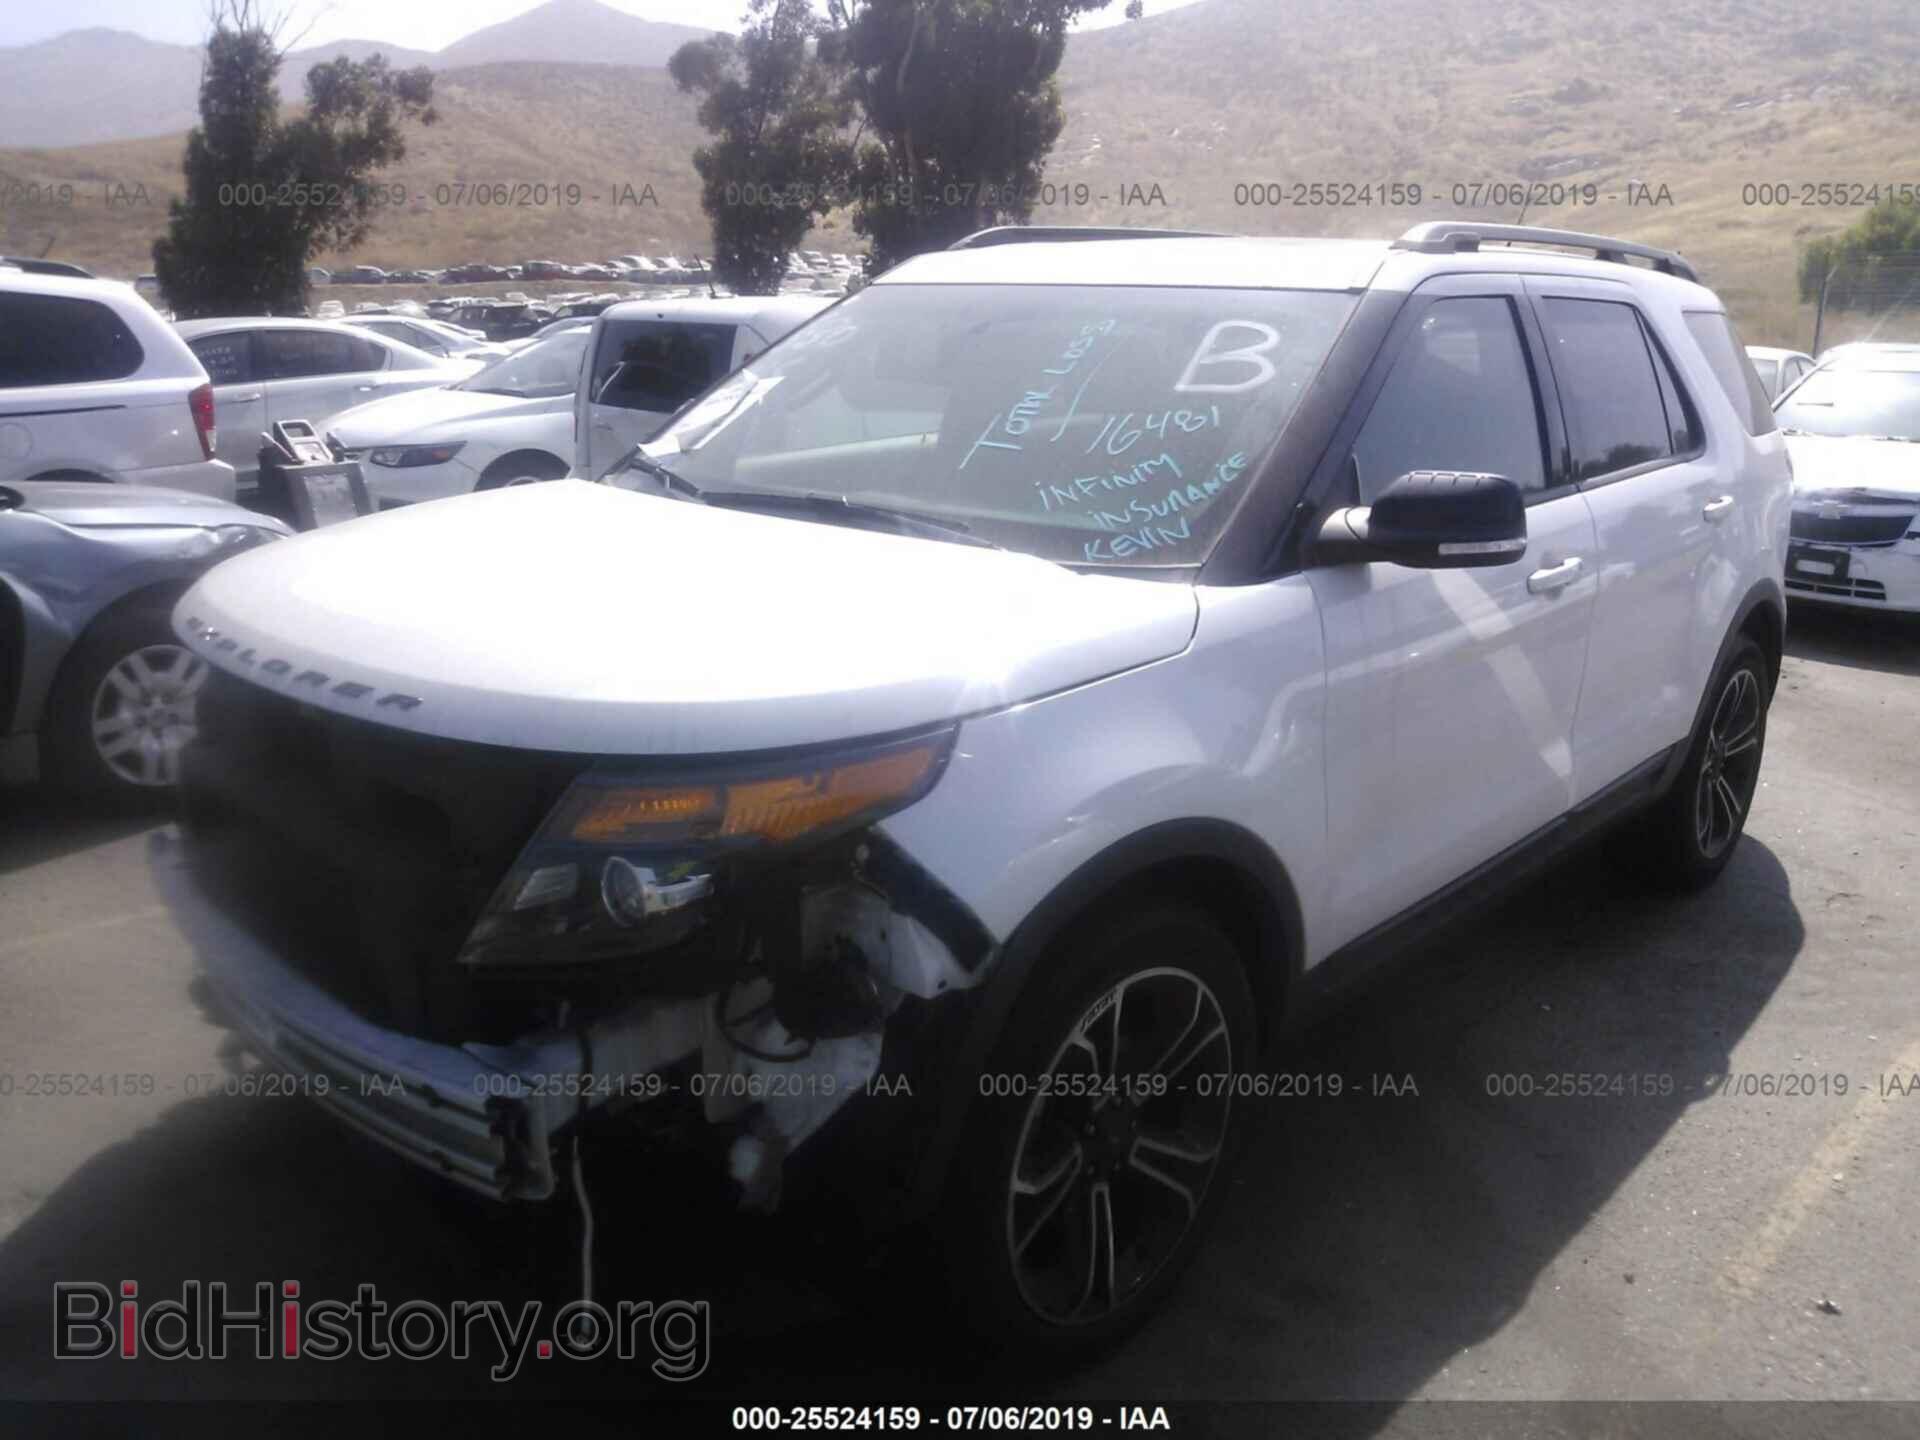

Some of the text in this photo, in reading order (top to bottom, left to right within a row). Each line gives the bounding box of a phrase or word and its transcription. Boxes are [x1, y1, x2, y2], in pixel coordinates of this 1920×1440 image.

[1174, 320, 1280, 392] B
[1086, 405, 1220, 455] 16481
[1083, 517, 1190, 561] KEVIN
